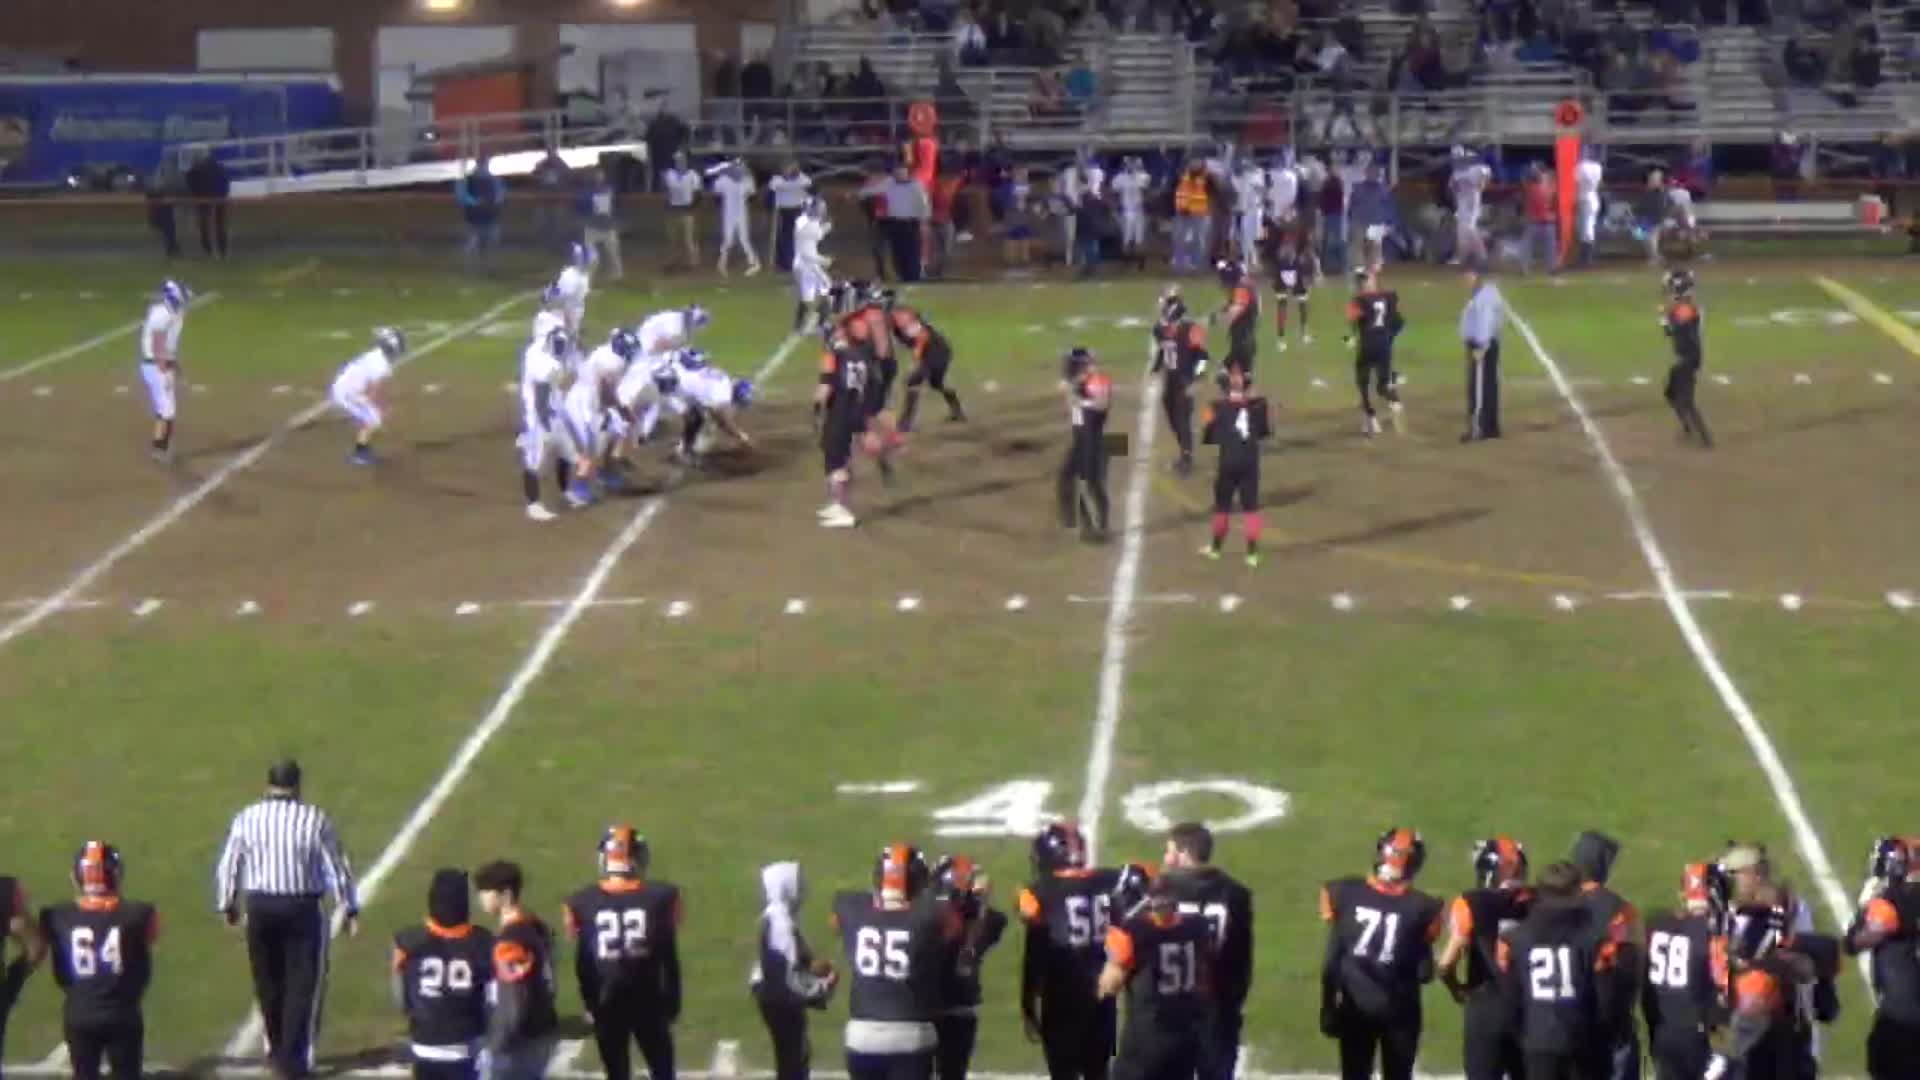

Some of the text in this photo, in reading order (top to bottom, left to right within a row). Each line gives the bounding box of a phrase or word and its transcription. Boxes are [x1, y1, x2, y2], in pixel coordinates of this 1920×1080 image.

[1234, 406, 1250, 440] 4
[931, 780, 1292, 834] 40
[71, 925, 124, 977] 64
[595, 909, 648, 958] 22
[856, 926, 911, 980] 65
[1353, 905, 1400, 963] 71
[1648, 931, 1691, 988] 58
[1157, 940, 1197, 995] 51
[1529, 945, 1576, 1000] 21
